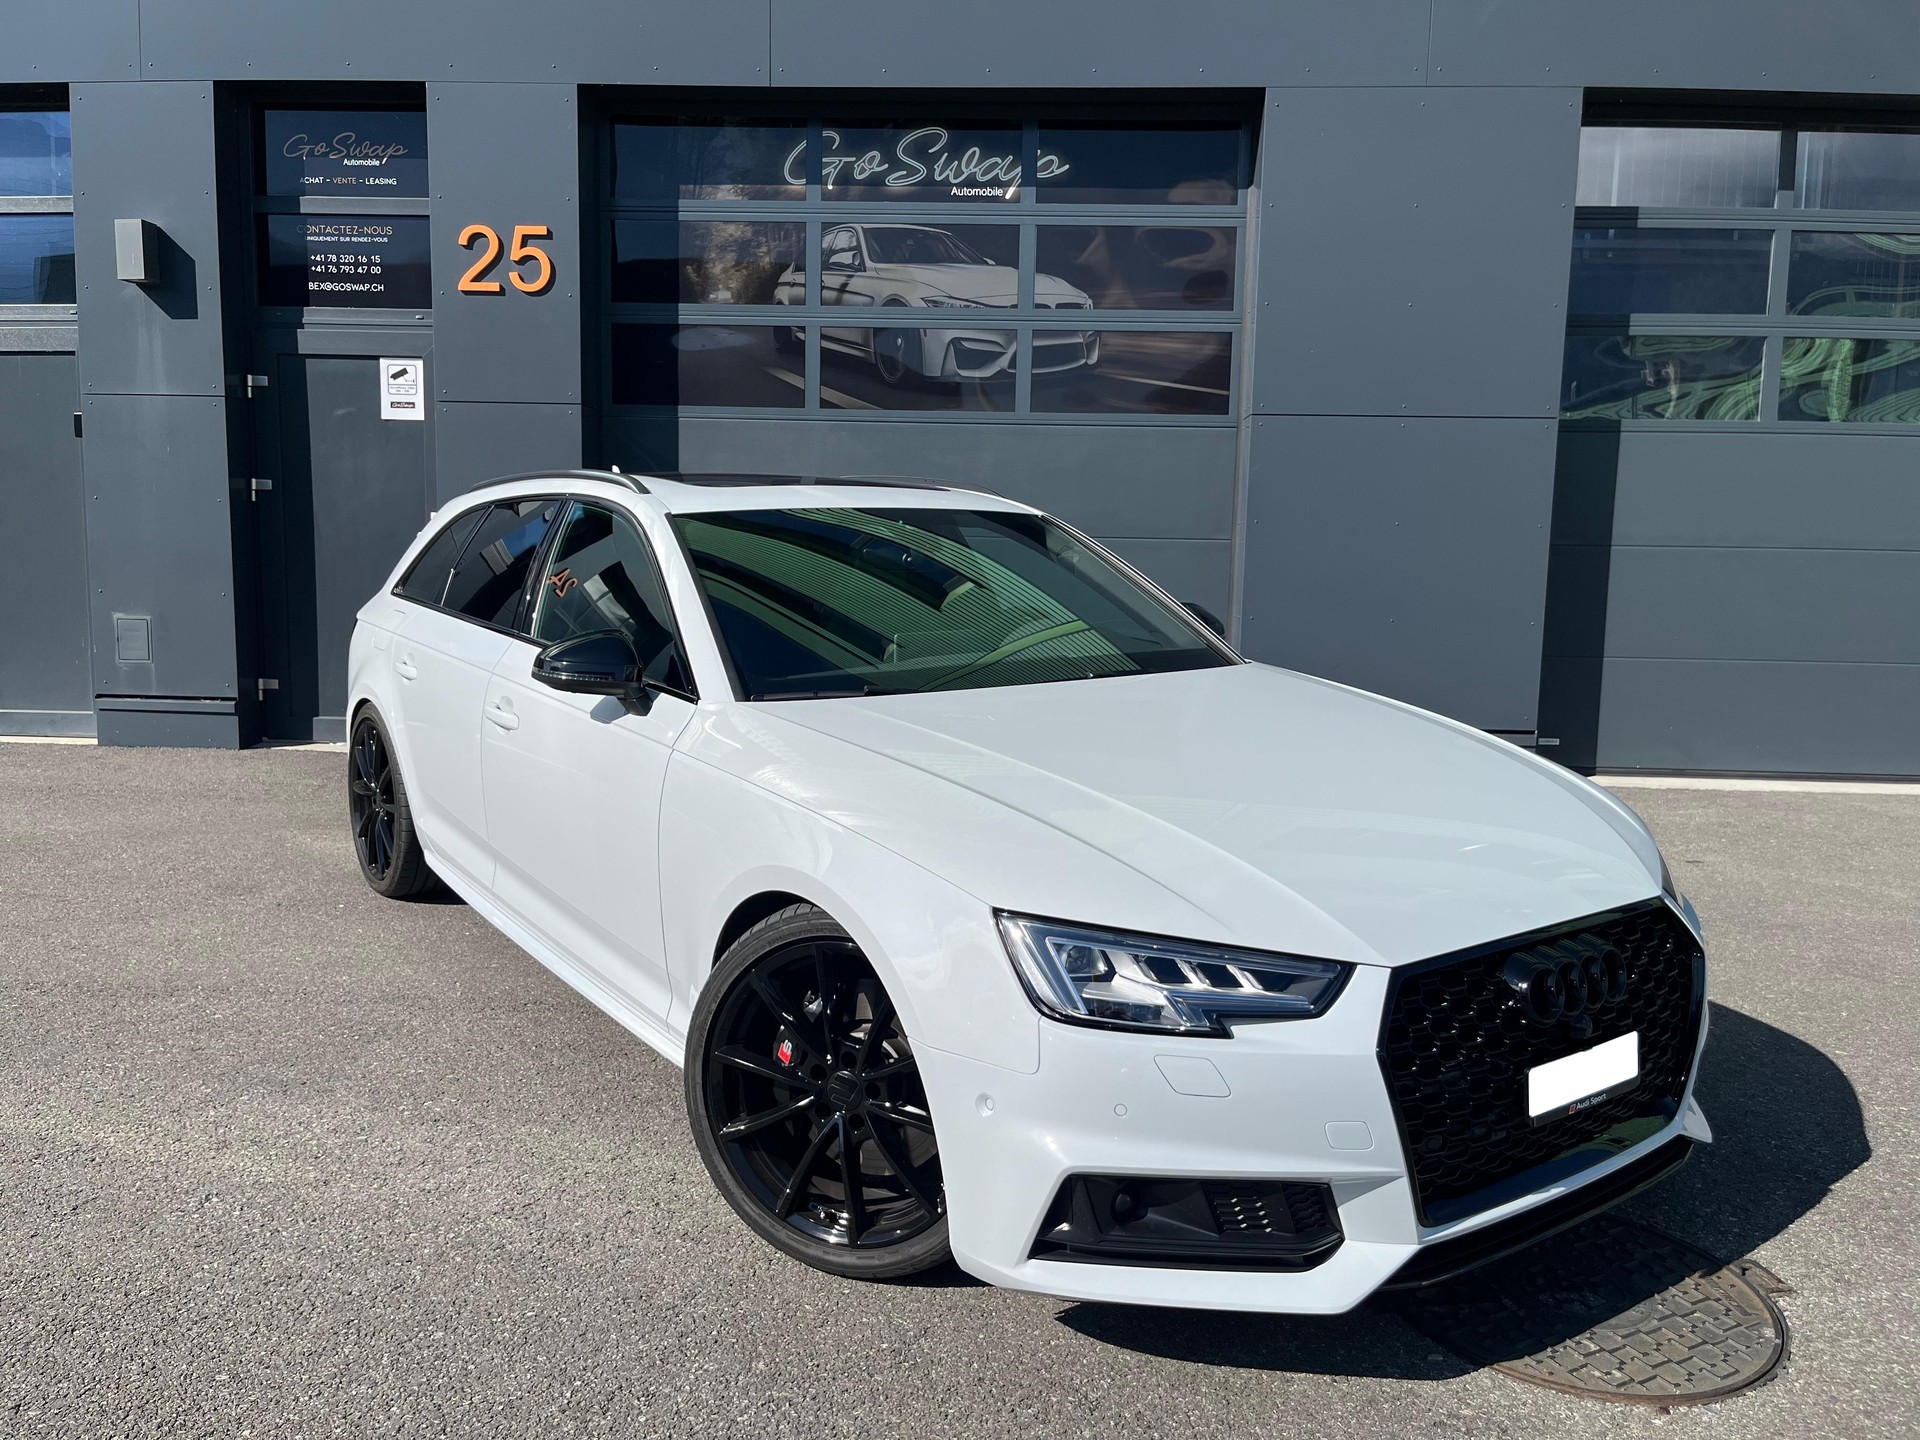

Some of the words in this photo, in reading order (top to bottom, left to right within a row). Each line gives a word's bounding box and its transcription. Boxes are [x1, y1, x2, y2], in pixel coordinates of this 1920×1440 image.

[343, 158, 380, 166] Automobile
[299, 176, 325, 185] ACHAT
[333, 177, 357, 185] VENTE
[365, 177, 397, 185] LEASING
[950, 186, 1004, 198] Automobile
[297, 224, 393, 236] CONTACTEZ-NOUS
[310, 253, 325, 262] +41
[327, 254, 338, 263] 78
[339, 254, 355, 263] 320
[358, 255, 368, 263] 16
[371, 255, 381, 263] 15
[457, 223, 552, 293] 25
[310, 265, 325, 273] +41
[327, 265, 338, 274] 76
[339, 265, 355, 274] 793
[357, 266, 368, 274] 47
[370, 266, 382, 275] 00
[308, 282, 385, 292] BEX@GOSWAP.CH
[1576, 1099, 1590, 1109] Audi
[1590, 1093, 1606, 1104] Sport
